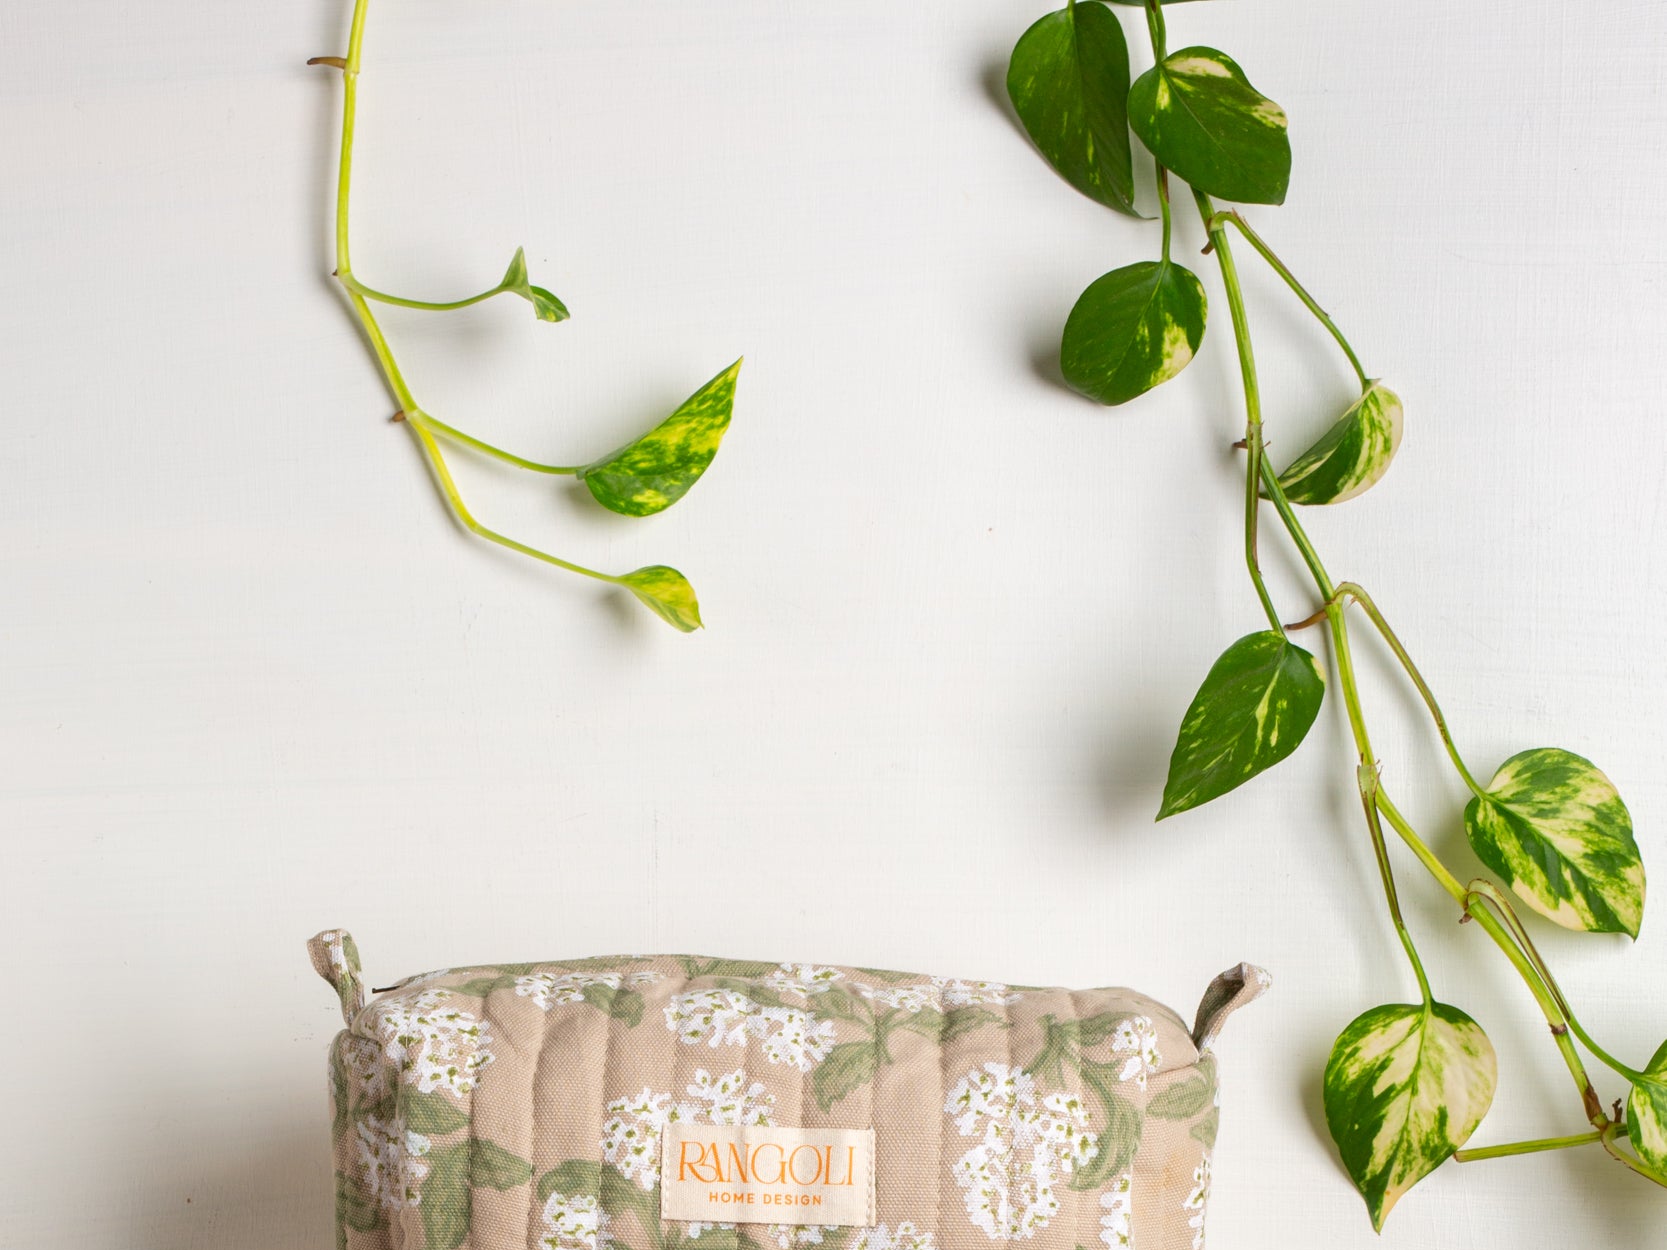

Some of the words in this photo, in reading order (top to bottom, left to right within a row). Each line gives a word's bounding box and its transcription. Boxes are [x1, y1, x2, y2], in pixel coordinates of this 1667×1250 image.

[677, 1140, 855, 1186] RANGOLI
[708, 1191, 756, 1205] HOME
[763, 1193, 823, 1206] DESIGN
